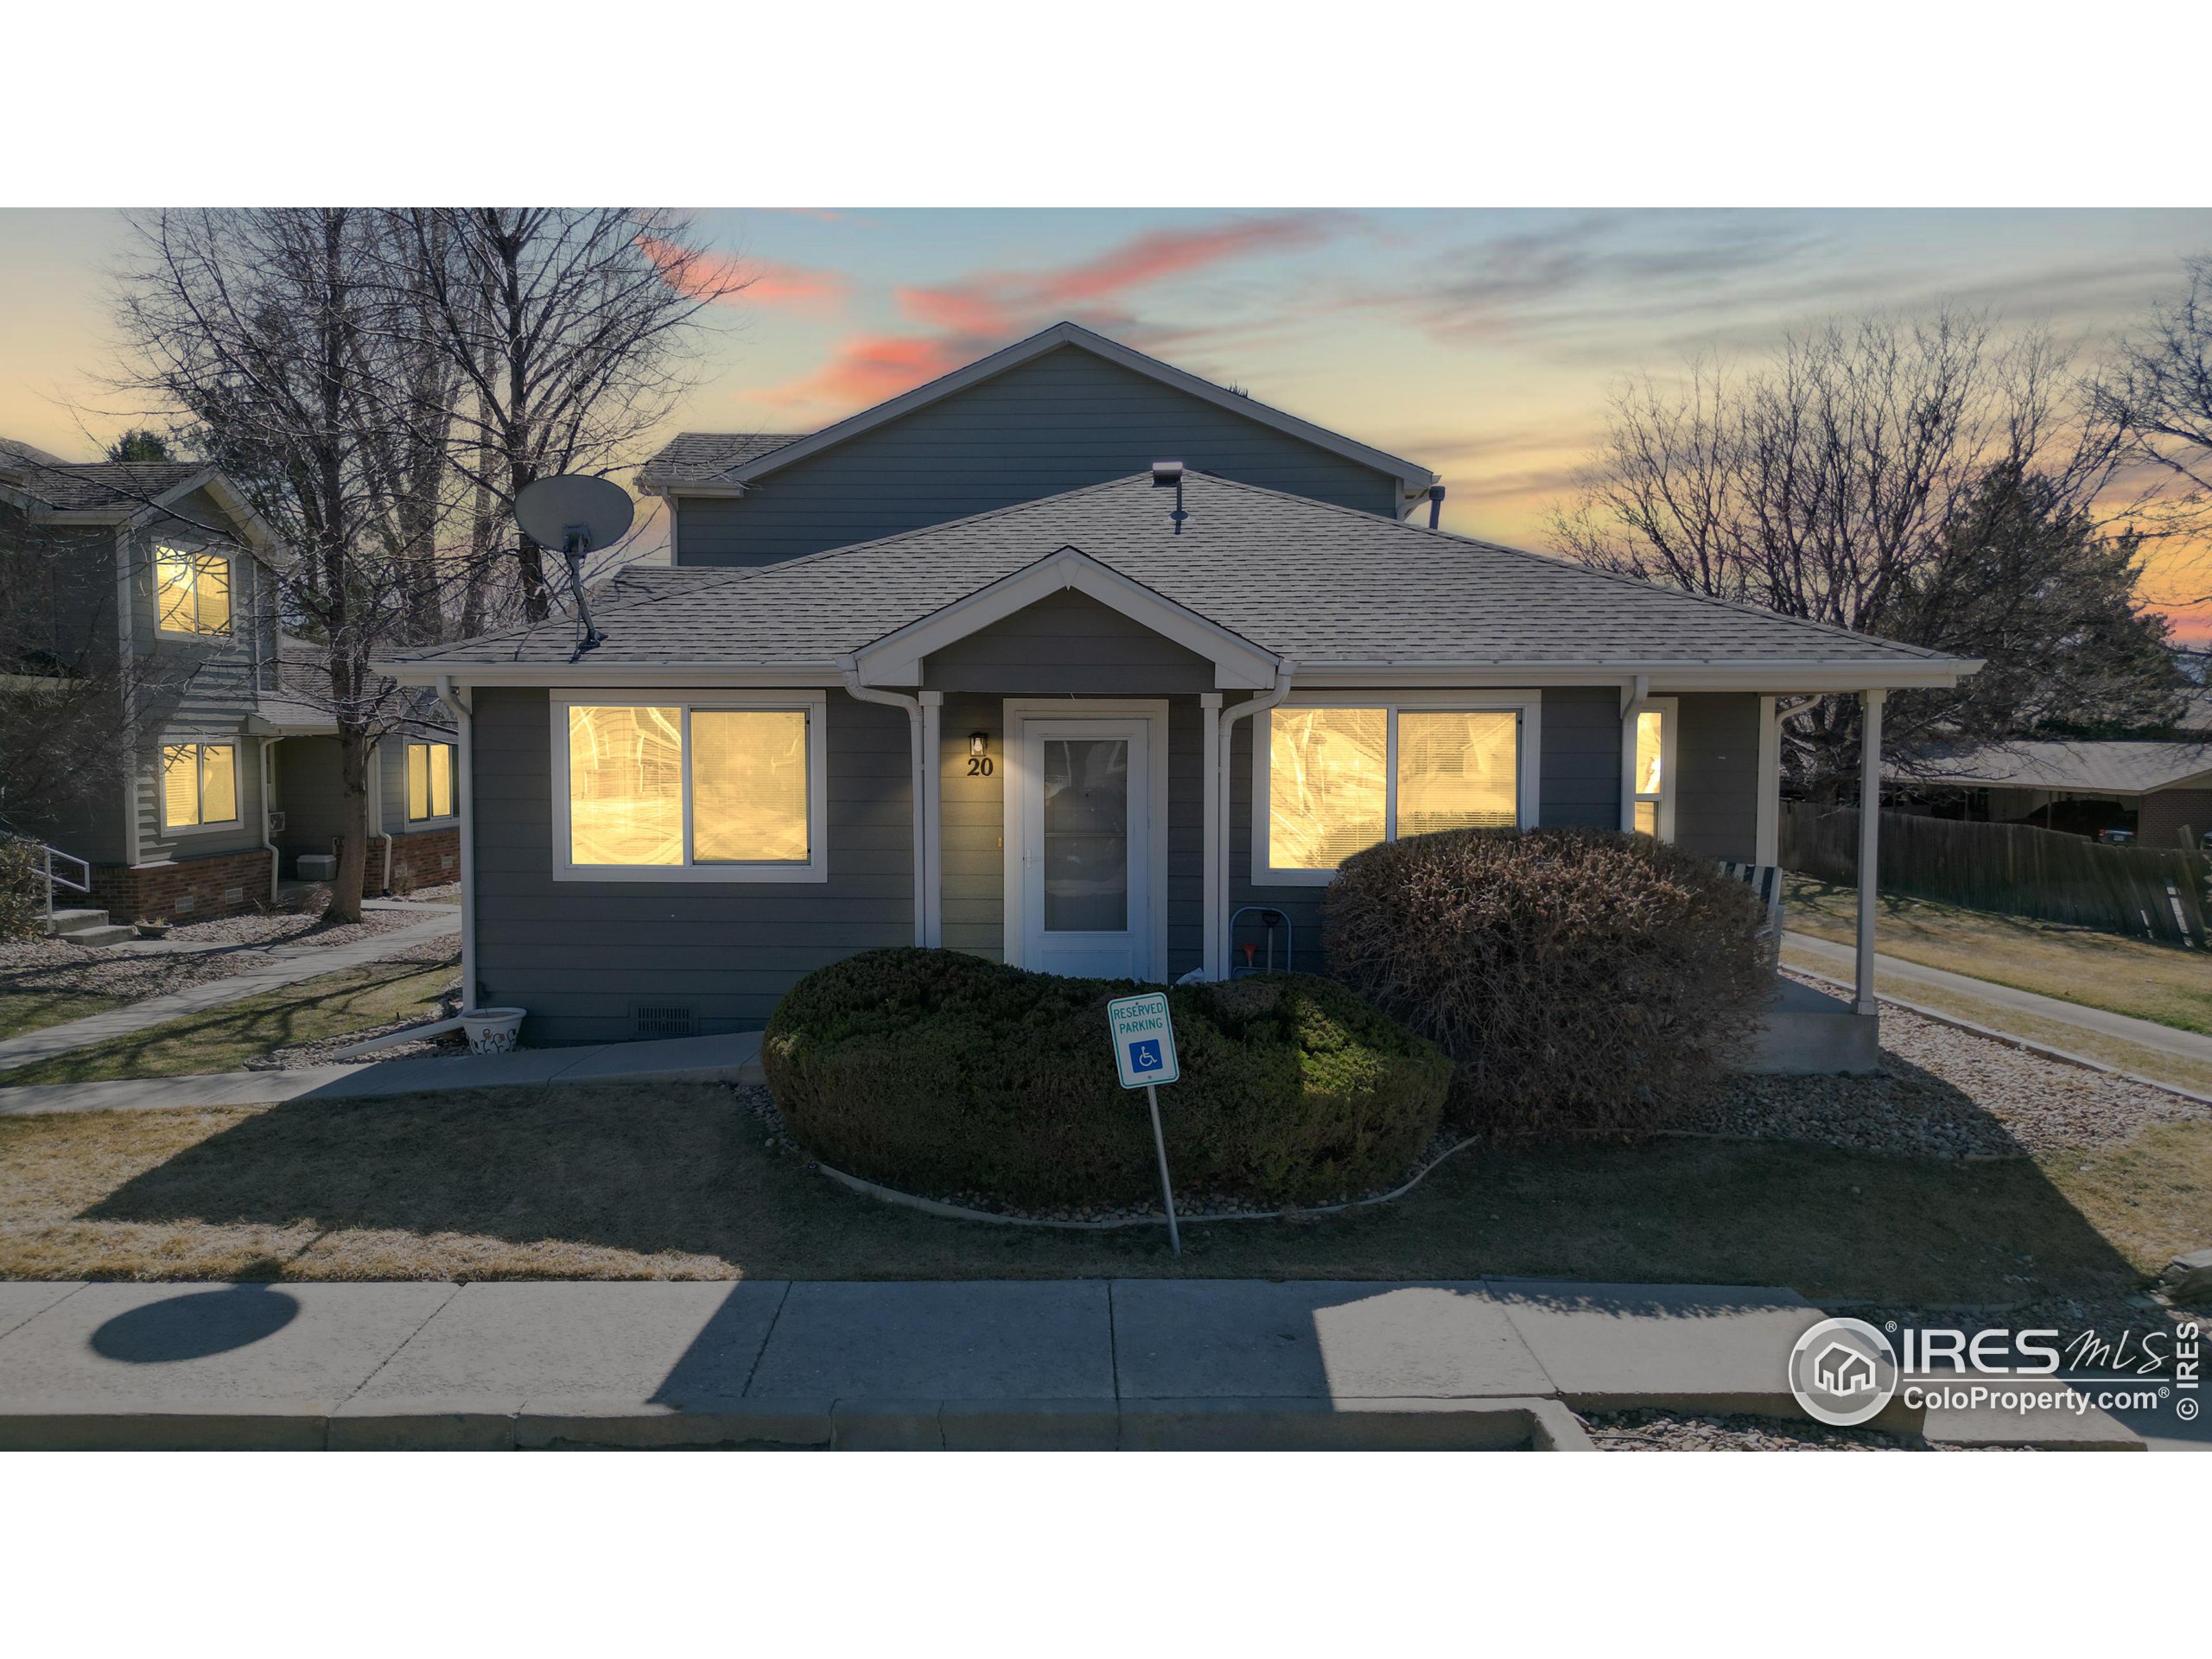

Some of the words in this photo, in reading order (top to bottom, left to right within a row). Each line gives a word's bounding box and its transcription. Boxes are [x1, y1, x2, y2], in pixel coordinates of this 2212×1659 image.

[967, 758, 994, 776] 20
[1113, 1002, 1164, 1020] RESERVED
[1119, 1018, 1163, 1034] PARKING
